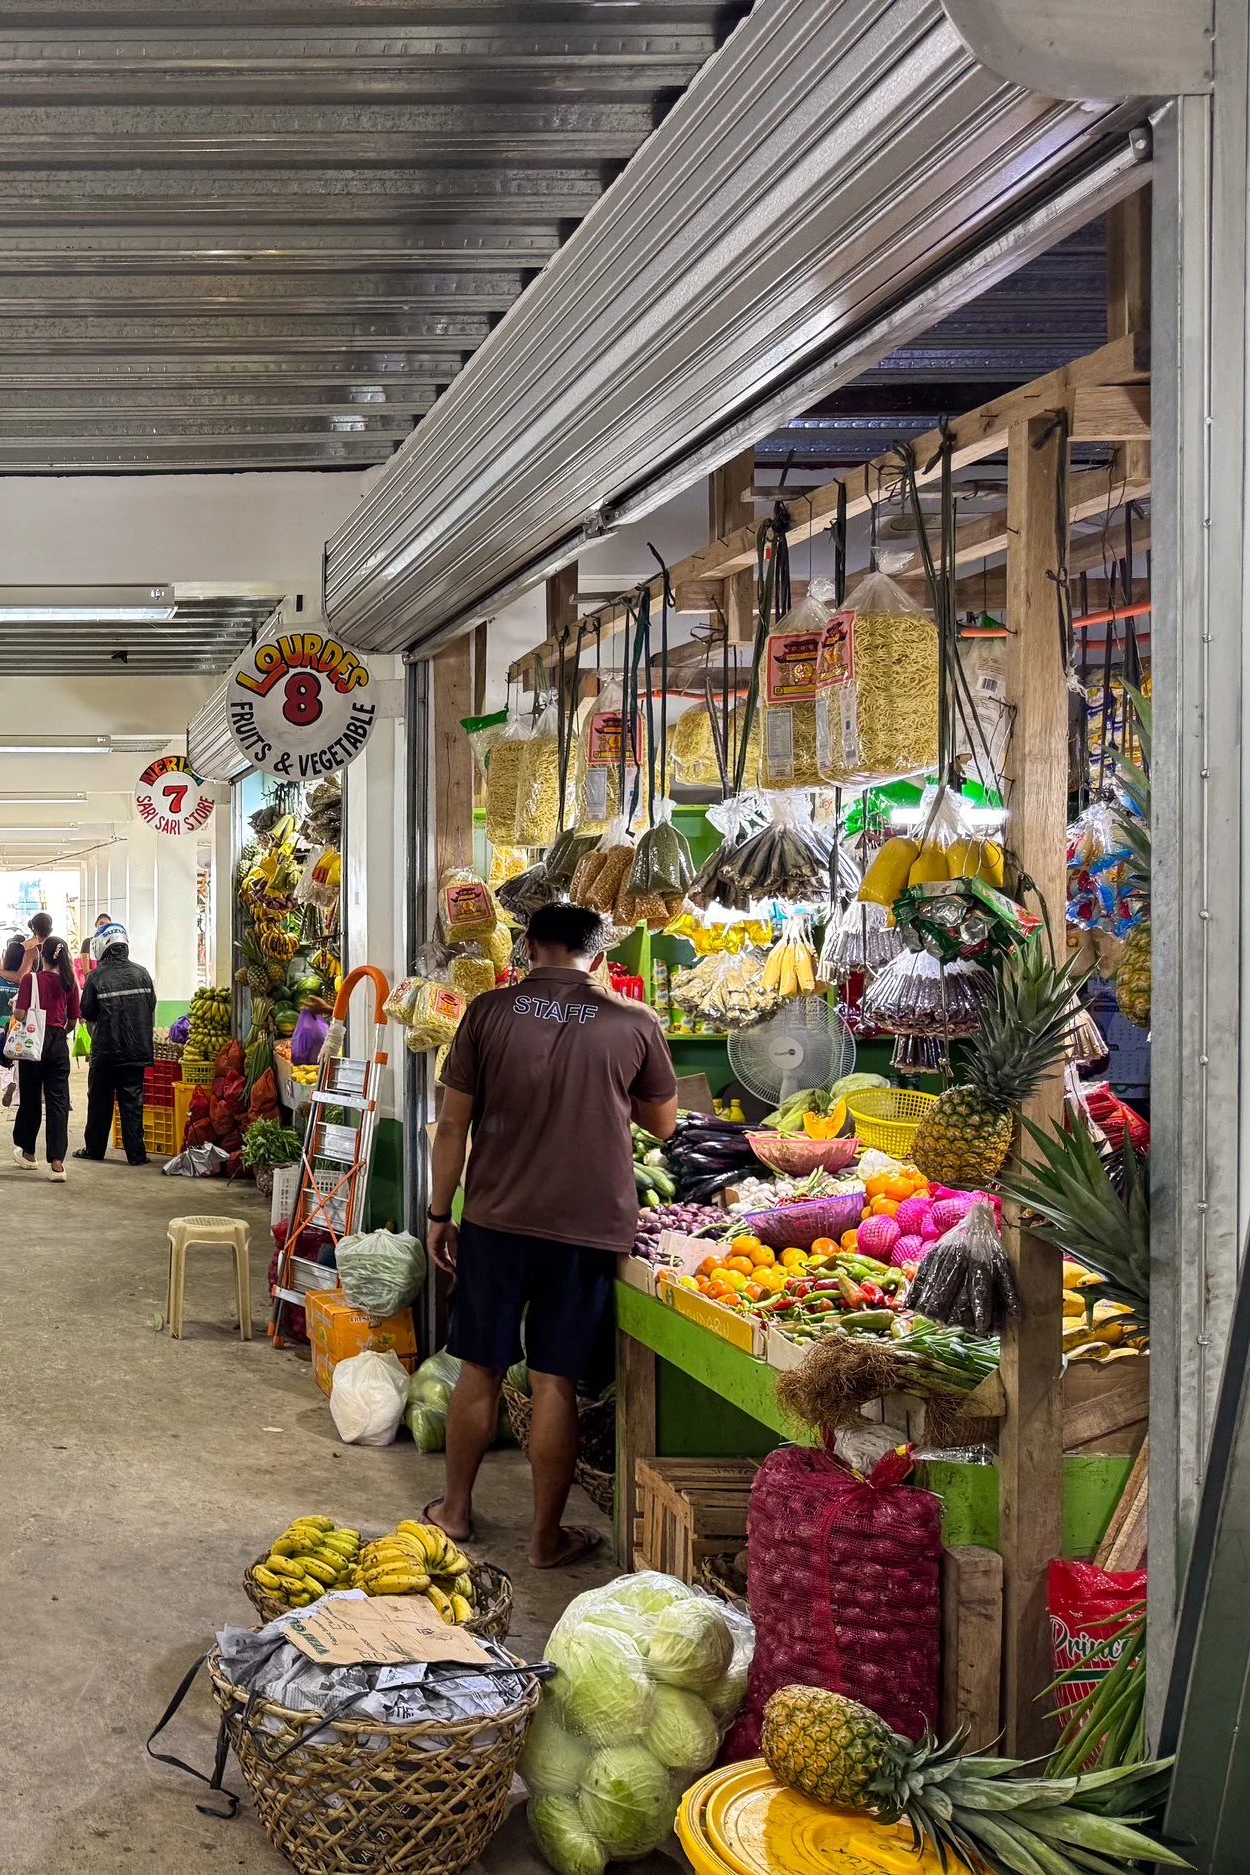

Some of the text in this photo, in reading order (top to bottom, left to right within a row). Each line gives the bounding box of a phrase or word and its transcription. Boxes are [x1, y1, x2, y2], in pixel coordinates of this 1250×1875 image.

[236, 633, 369, 698] LOURDES
[282, 671, 323, 727] 8
[230, 701, 376, 776] FRUITS & VEGETABLE
[136, 795, 216, 835] SARI SARI STORE
[162, 785, 188, 814] 7
[513, 995, 598, 1024] STAFF
